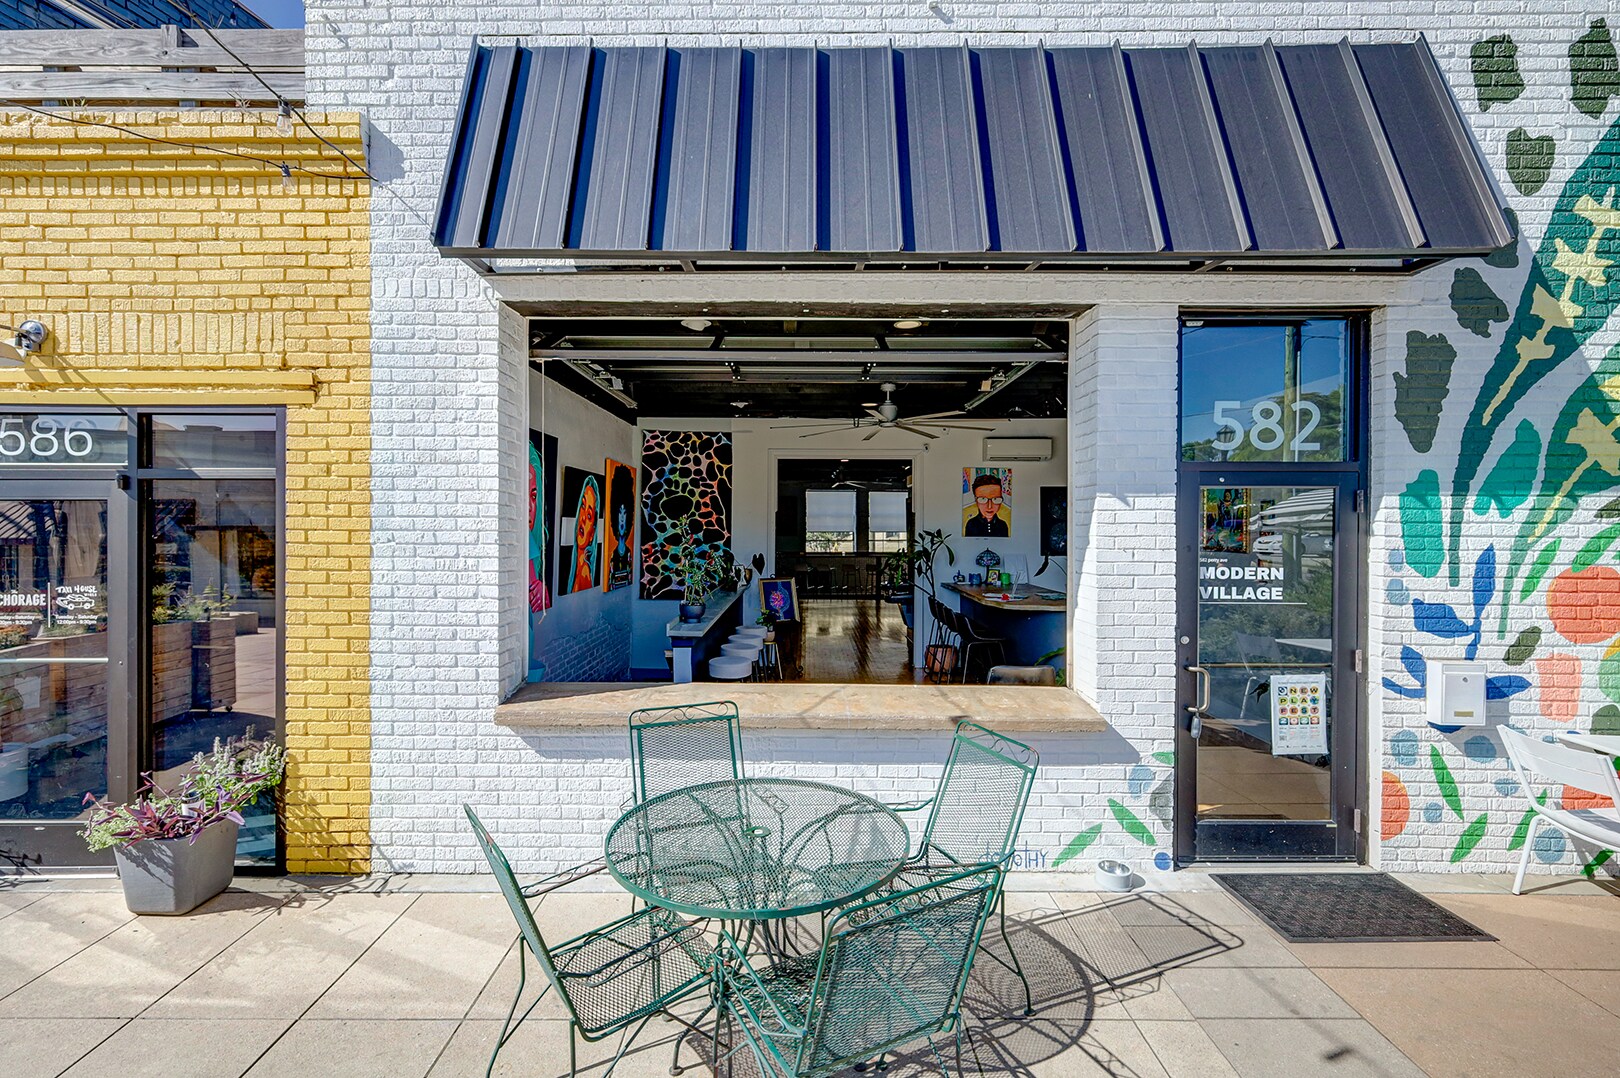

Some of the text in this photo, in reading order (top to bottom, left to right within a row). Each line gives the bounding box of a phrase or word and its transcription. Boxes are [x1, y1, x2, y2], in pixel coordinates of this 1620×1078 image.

[1211, 400, 1321, 451] 582
[0, 418, 93, 457] 586
[1199, 567, 1284, 580] MODERN
[74, 585, 98, 593] HOUSE
[1199, 586, 1284, 600] VILLAGE
